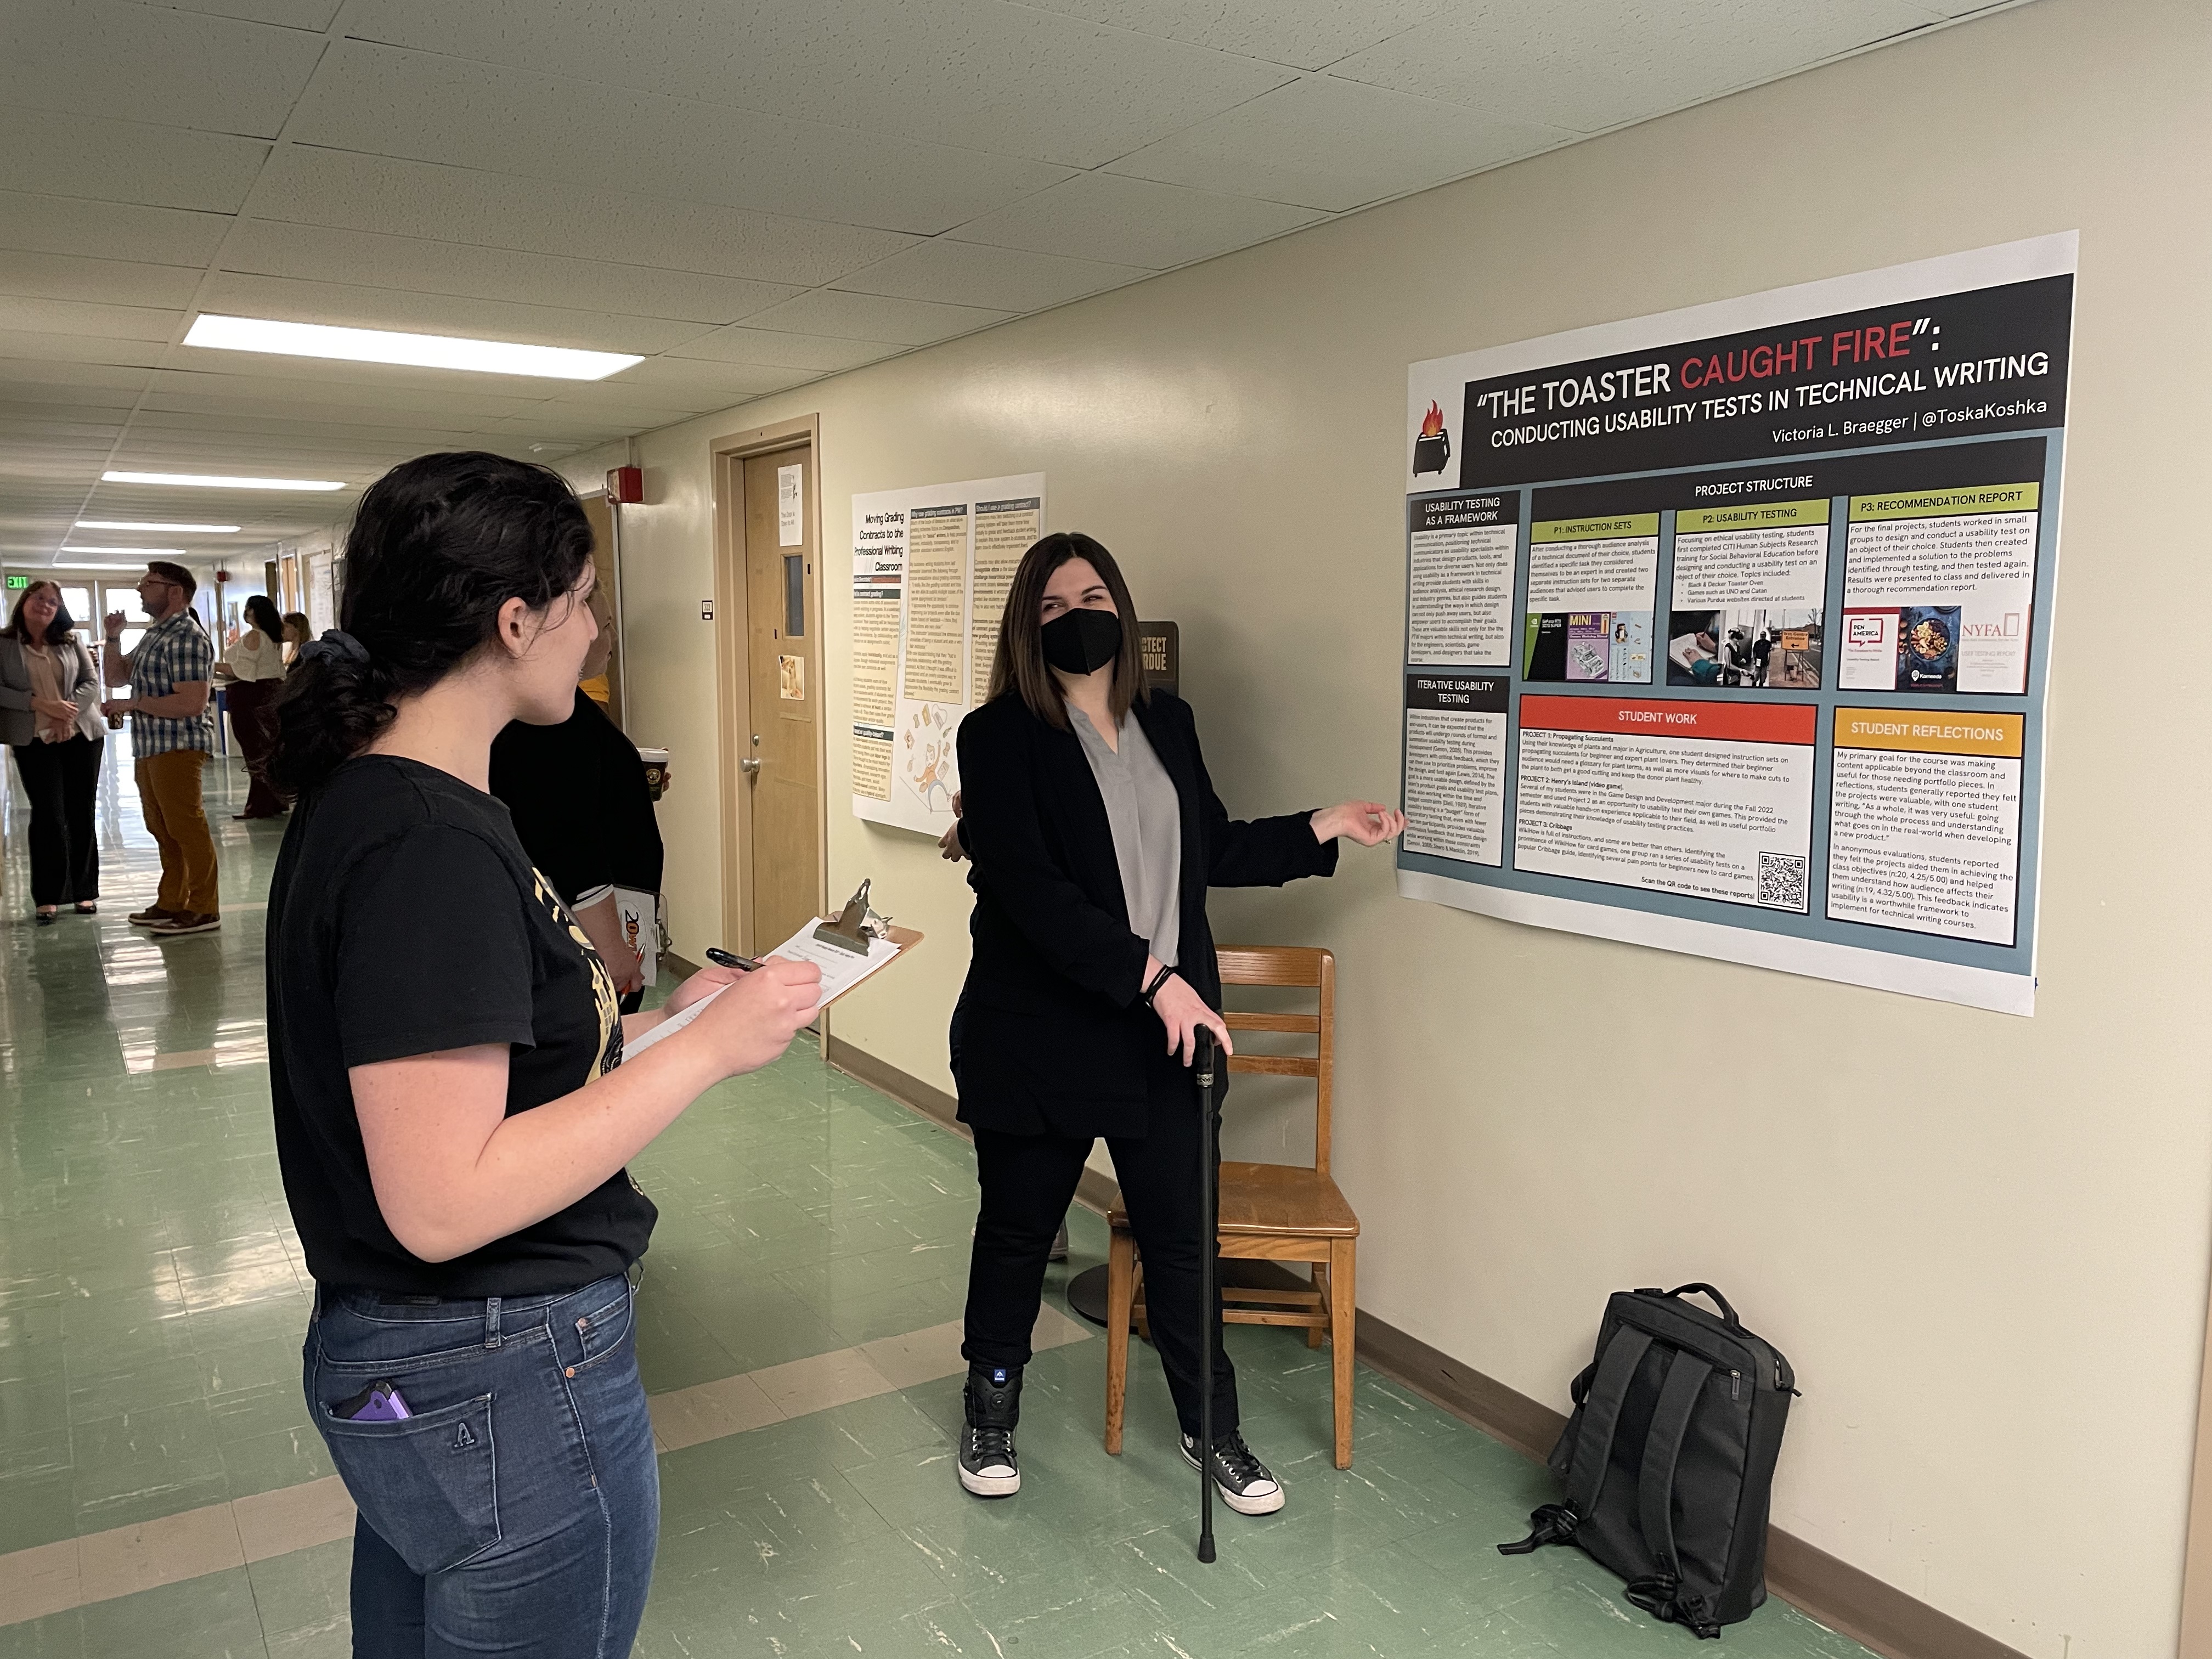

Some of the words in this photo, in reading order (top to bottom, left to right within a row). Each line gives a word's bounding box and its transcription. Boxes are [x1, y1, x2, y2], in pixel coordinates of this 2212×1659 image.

[1542, 363, 1671, 410] TOASTER
[1681, 336, 1822, 388] CAUGHT
[1491, 416, 1599, 447] CONDUCTING
[1605, 402, 1697, 432] USABILITY
[1701, 393, 1762, 419] TESTS
[1769, 388, 1788, 411] IN
[1795, 369, 1926, 407] TECHNICAL
[1934, 352, 2048, 387] WRITING
[1772, 425, 1823, 442] Victoria
[1828, 423, 1838, 436] L.
[1843, 417, 1909, 435] Braegger
[1922, 398, 2046, 426] @ToskaKoshka
[1695, 482, 1744, 496] PROJECT
[1746, 475, 1813, 492] STRUCTURE
[1425, 500, 1464, 512] USABILITY
[1465, 497, 1500, 509] TESTING
[1861, 502, 1874, 512] P3:
[1877, 494, 1976, 510] RECOMMENDATION
[1978, 490, 2023, 503] REPORT
[865, 513, 883, 526] Moving
[884, 511, 904, 524] Grading
[1425, 516, 1435, 526] AS
[1437, 516, 1442, 524] A
[1444, 511, 1498, 524] FRAMEWORK
[1702, 515, 1714, 523] P2:
[1717, 511, 1758, 522] USABILITY
[1760, 508, 1797, 519] TESTING
[1565, 522, 1612, 533] INSTRUCTION
[1613, 521, 1631, 529] SETS
[1894, 523, 1927, 532] projects,
[1929, 520, 1961, 528] students
[1963, 517, 1993, 526] worked
[2004, 515, 2027, 523] small
[860, 530, 885, 540] Contracts
[886, 529, 893, 539] to
[894, 528, 904, 538] the
[1849, 537, 1874, 545] groups
[1926, 531, 1956, 539] conduct
[1965, 528, 1998, 537] usability
[854, 546, 883, 556] Professional
[884, 545, 903, 557] Writing
[1859, 545, 1881, 554] object
[1995, 537, 2027, 546] created
[1863, 554, 1910, 563] implemented
[1974, 550, 2012, 559] problems
[875, 561, 903, 572] Classroom
[1882, 565, 1910, 573] through
[1912, 563, 1939, 572] testing,
[8, 577, 27, 588] EXIT
[1894, 574, 1931, 583] presented
[1980, 571, 2019, 579] delivered
[1853, 586, 1884, 594] thorough
[1570, 614, 1592, 626] MINI
[1962, 624, 2002, 636] NYFA
[1141, 637, 1167, 652] OTECT
[1142, 653, 1166, 670] RDUE
[1418, 680, 1453, 690] ITERATIVE
[1455, 681, 1494, 691] USABILITY
[1437, 693, 1469, 703] TESTING
[1618, 710, 1663, 722] STUDENT
[1665, 713, 1697, 724] WORK
[1553, 732, 1584, 741] Propagating
[1851, 721, 1909, 735] STUDENT
[1912, 724, 2003, 741] REFLECTIONS
[1837, 751, 1847, 759] My
[1849, 752, 1877, 761] primary
[1967, 760, 1995, 769] making
[1865, 764, 1902, 772] applicable
[1904, 765, 1931, 774] beyond
[1948, 769, 1988, 778] classroom
[1730, 891, 1754, 899] reports!
